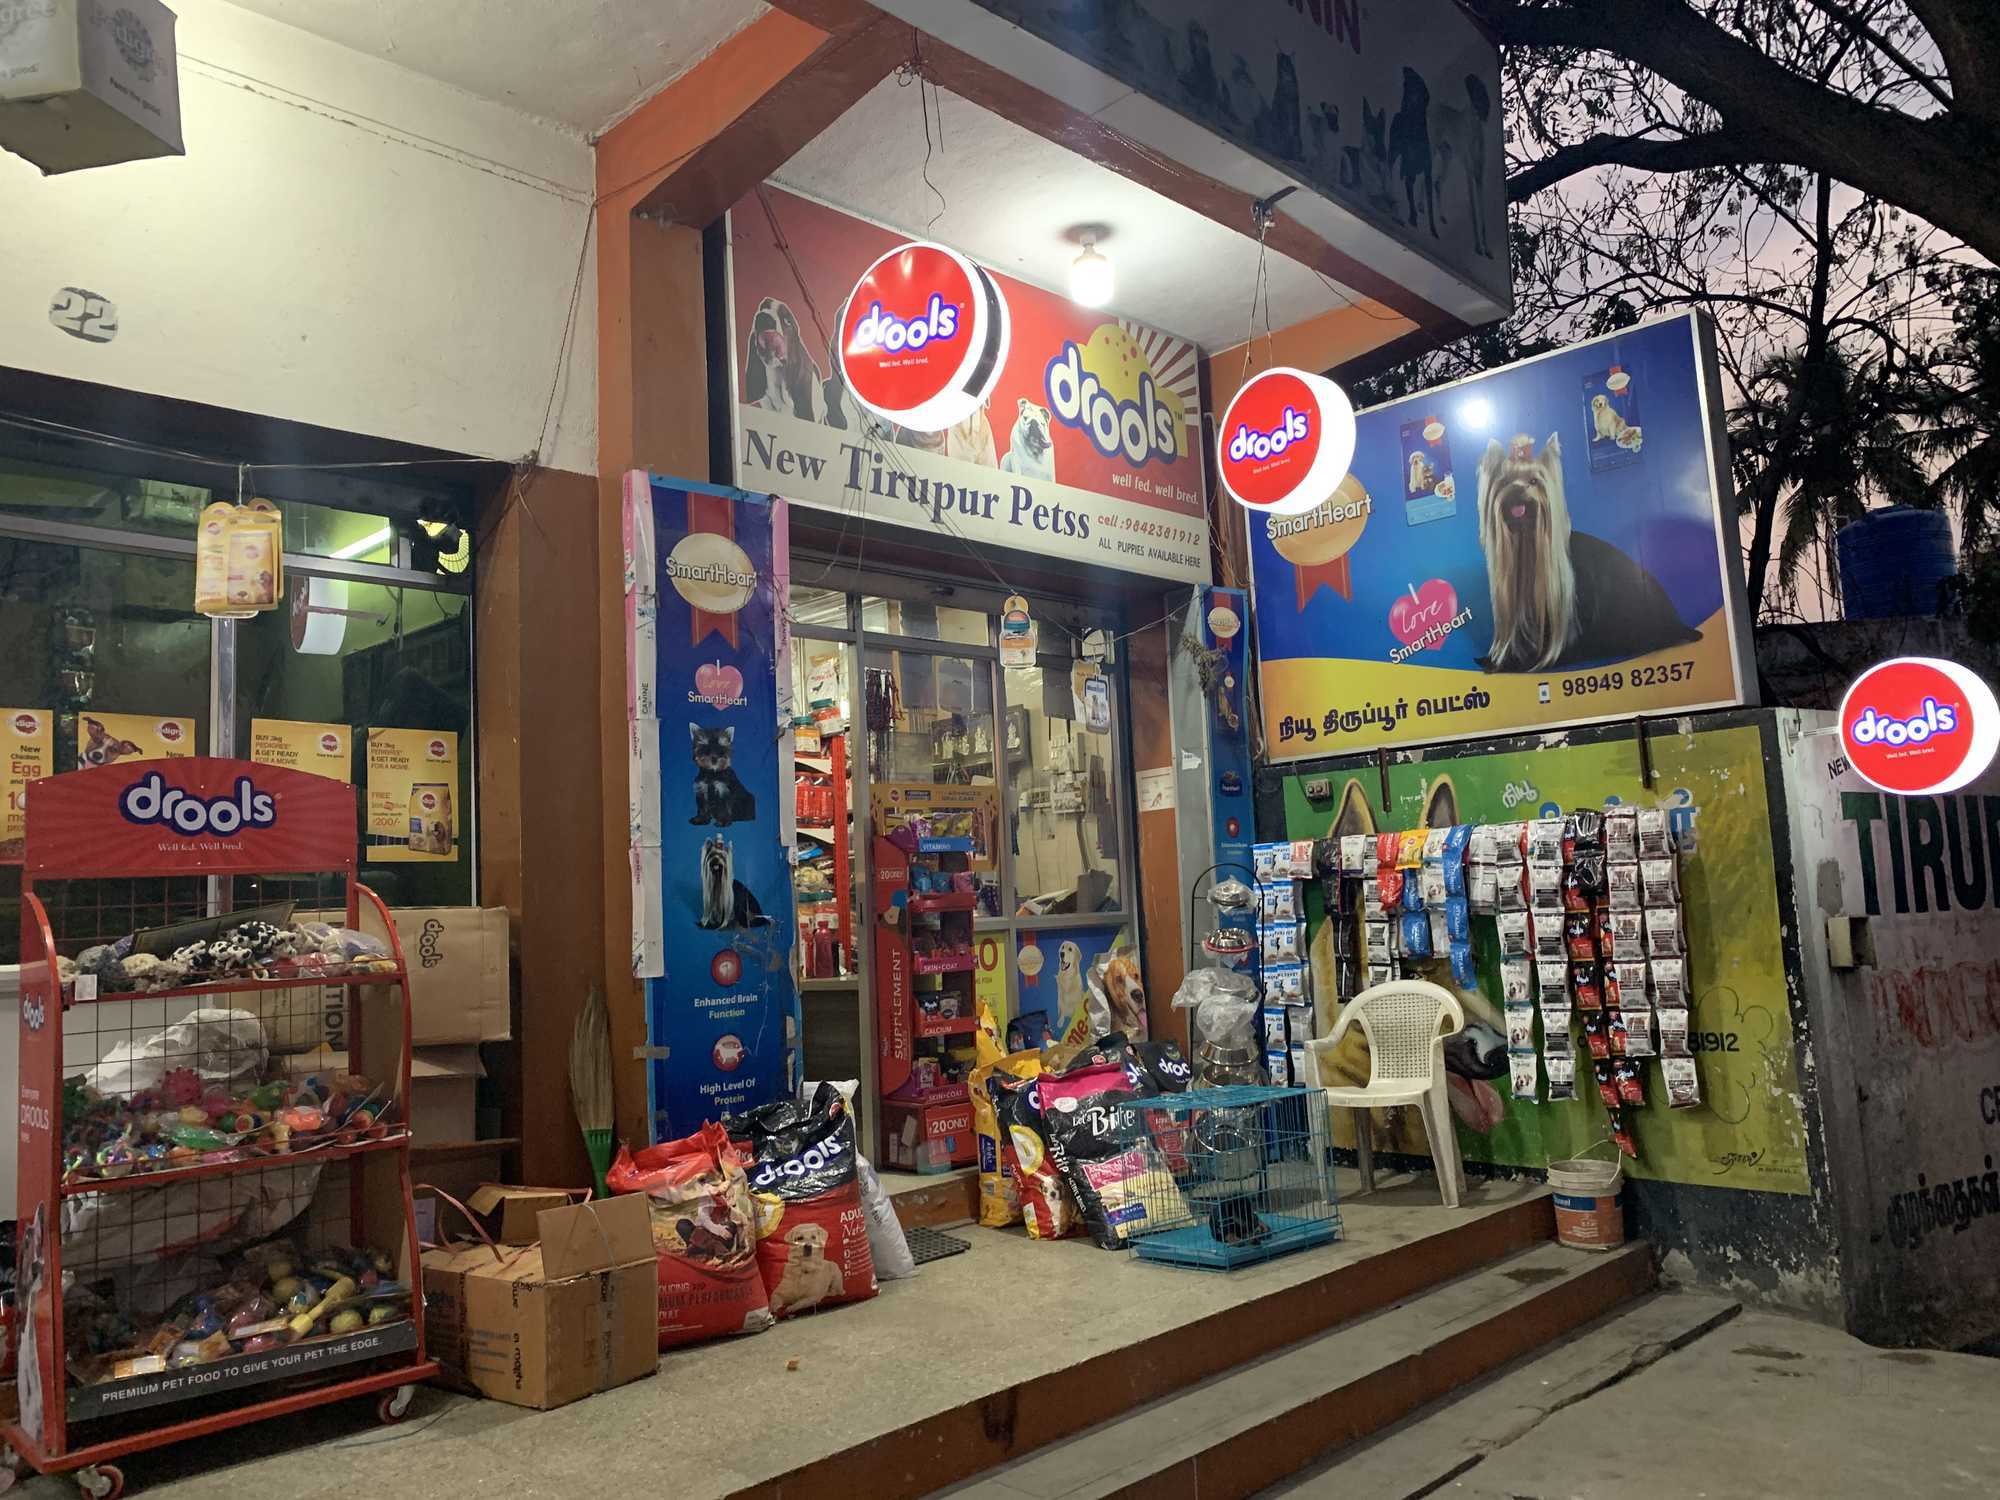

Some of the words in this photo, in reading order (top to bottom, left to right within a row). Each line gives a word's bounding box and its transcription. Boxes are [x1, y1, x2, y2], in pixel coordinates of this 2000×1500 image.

[855, 294, 958, 352] drools
[1047, 342, 1176, 466] drools
[1230, 407, 1308, 461] drools
[742, 428, 827, 482] New
[839, 442, 1000, 526] Tirupur
[1008, 484, 1091, 540] Petss
[1112, 472, 1132, 489] well
[1134, 475, 1152, 493] fed.
[1155, 482, 1174, 498] well
[1176, 486, 1199, 505] bred.
[1265, 493, 1373, 541] SmartHeart
[665, 556, 758, 588] SmartHeart
[1098, 537, 1112, 550] ALL
[1148, 548, 1183, 565] AVAILABLE
[1184, 557, 1201, 568] HERE
[1389, 606, 1473, 664] SmartHeart
[688, 690, 748, 706] SmartHeart
[1562, 672, 1623, 697] 98949
[1630, 660, 1695, 688] 82357
[1279, 715, 1317, 742] நியூ
[1323, 697, 1409, 737] திருப்பூர்
[1416, 686, 1490, 717] பெட்ஸ்
[1854, 698, 1956, 745] drools
[11, 762, 41, 777] Egg
[277, 750, 299, 758] READY
[123, 773, 275, 834] drools
[419, 918, 445, 968] drools
[694, 994, 737, 1008] Enhanced
[738, 993, 759, 1004] Brain
[708, 1008, 746, 1020] Function
[892, 949, 903, 1060] SUPPLEMENT
[700, 1083, 721, 1096] High
[722, 1080, 744, 1093] Level
[746, 1077, 757, 1088] Of
[714, 1094, 745, 1106] Protein
[21, 1104, 49, 1130] DROOLS
[755, 1136, 843, 1186] drools
[102, 1382, 159, 1403] PREMIUM
[162, 1377, 185, 1391] PET
[187, 1370, 221, 1386] FOOD
[224, 1367, 240, 1377] TO
[242, 1360, 269, 1374] GIVE
[271, 1352, 302, 1369] YOUR
[303, 1349, 324, 1362] PET
[328, 1343, 349, 1355] THE
